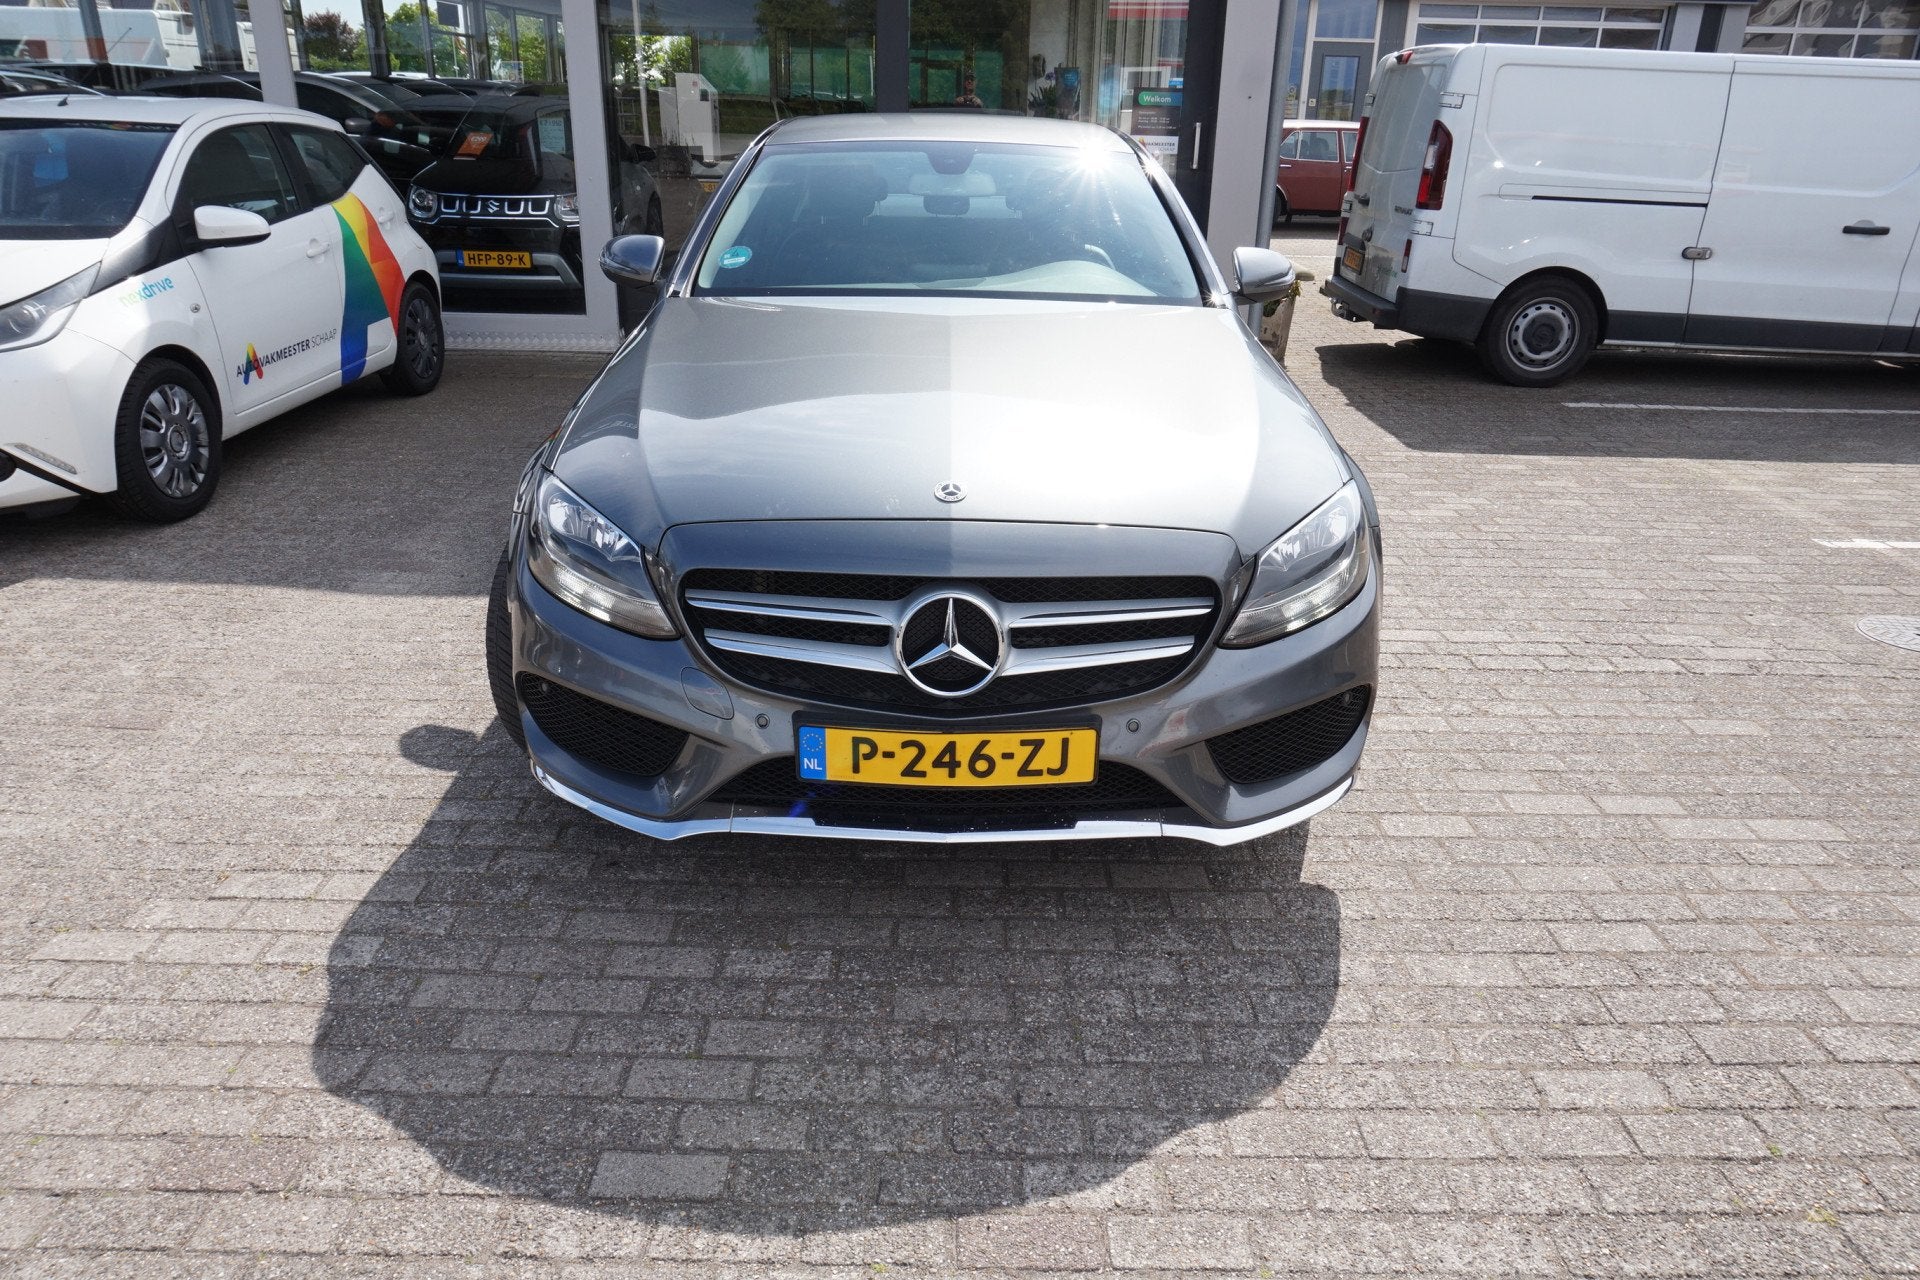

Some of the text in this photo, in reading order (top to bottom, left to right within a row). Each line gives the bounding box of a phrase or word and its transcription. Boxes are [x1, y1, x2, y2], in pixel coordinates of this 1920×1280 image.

[1144, 95, 1171, 103] Welkom
[467, 253, 526, 266] HFP-89-K
[119, 277, 174, 306] nexdrive
[310, 328, 338, 348] SCHAAP
[803, 735, 1070, 778] NL P-246-ZJ
